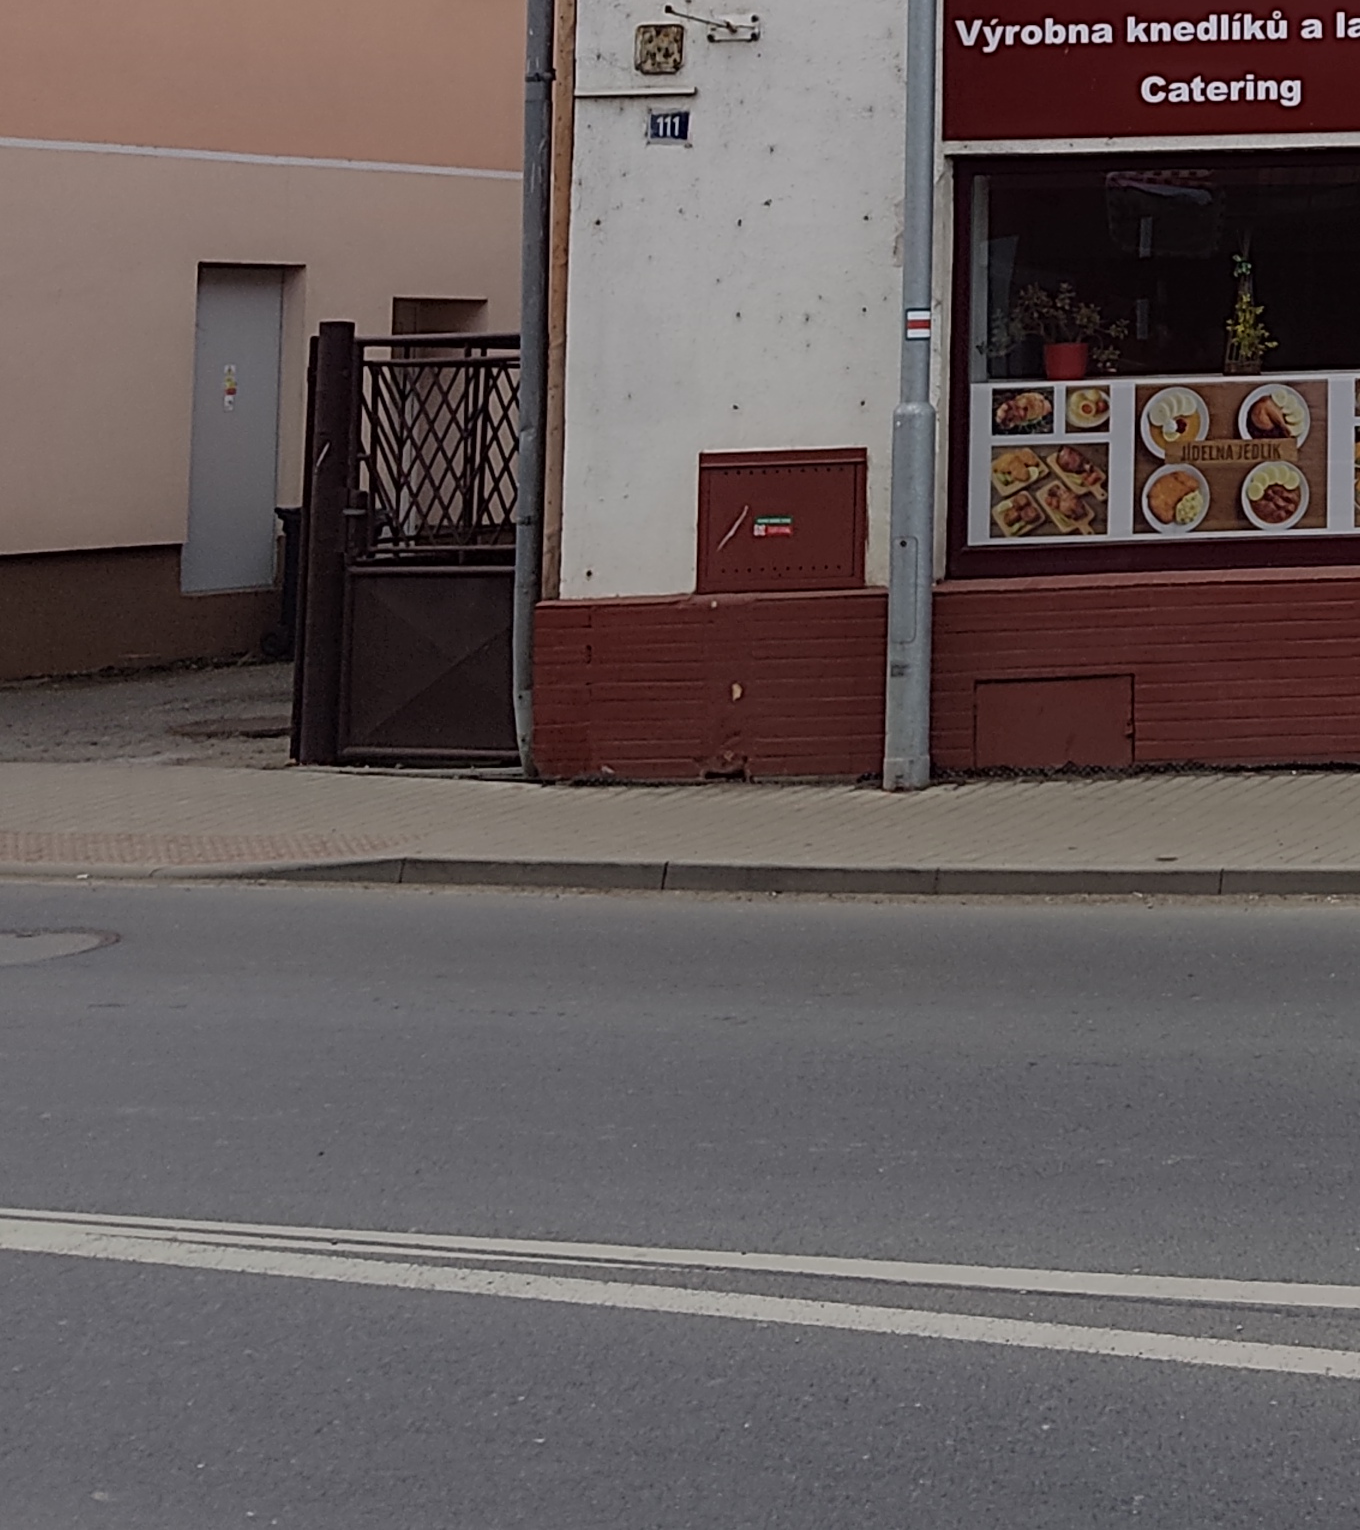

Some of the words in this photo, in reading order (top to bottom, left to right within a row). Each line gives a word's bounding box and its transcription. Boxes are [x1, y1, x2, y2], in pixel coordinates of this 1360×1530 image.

[955, 17, 1113, 53] Výrobna
[1127, 9, 1288, 44] knedlíků
[1300, 19, 1323, 40] a
[1141, 73, 1302, 107] Catering
[656, 115, 681, 138] 111
